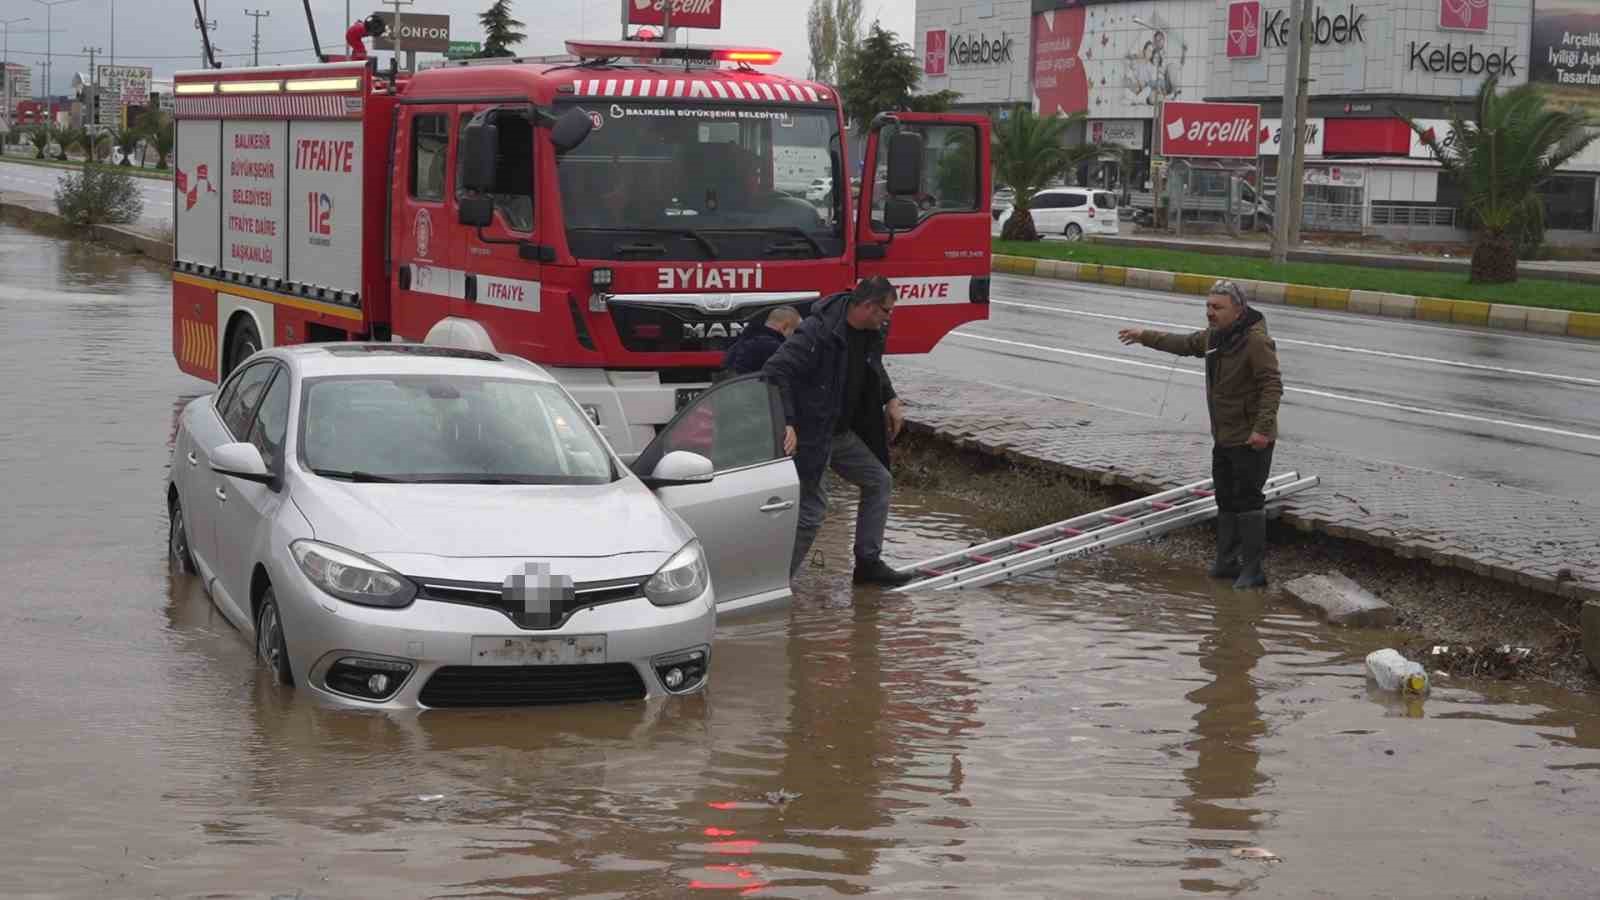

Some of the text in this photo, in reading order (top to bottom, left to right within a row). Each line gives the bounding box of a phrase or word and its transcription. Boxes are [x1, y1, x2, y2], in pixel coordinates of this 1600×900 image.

[654, 0, 714, 16] açelik
[1264, 4, 1364, 47] Kebek
[949, 31, 1014, 65] Kelebek
[1409, 41, 1517, 77] Kelebek
[234, 132, 271, 150] BALIKESİR
[1187, 117, 1254, 147] arçelik
[295, 139, 354, 173] İTFAİYE
[230, 159, 275, 181] BÜYÜKŞEHİR
[232, 188, 272, 207] BELEDİYESİ
[308, 191, 332, 235] 112
[229, 214, 276, 237] İTFAİYE DAİRE
[231, 243, 273, 265] BAŞKANLIĞI
[896, 283, 949, 299] FAİYE
